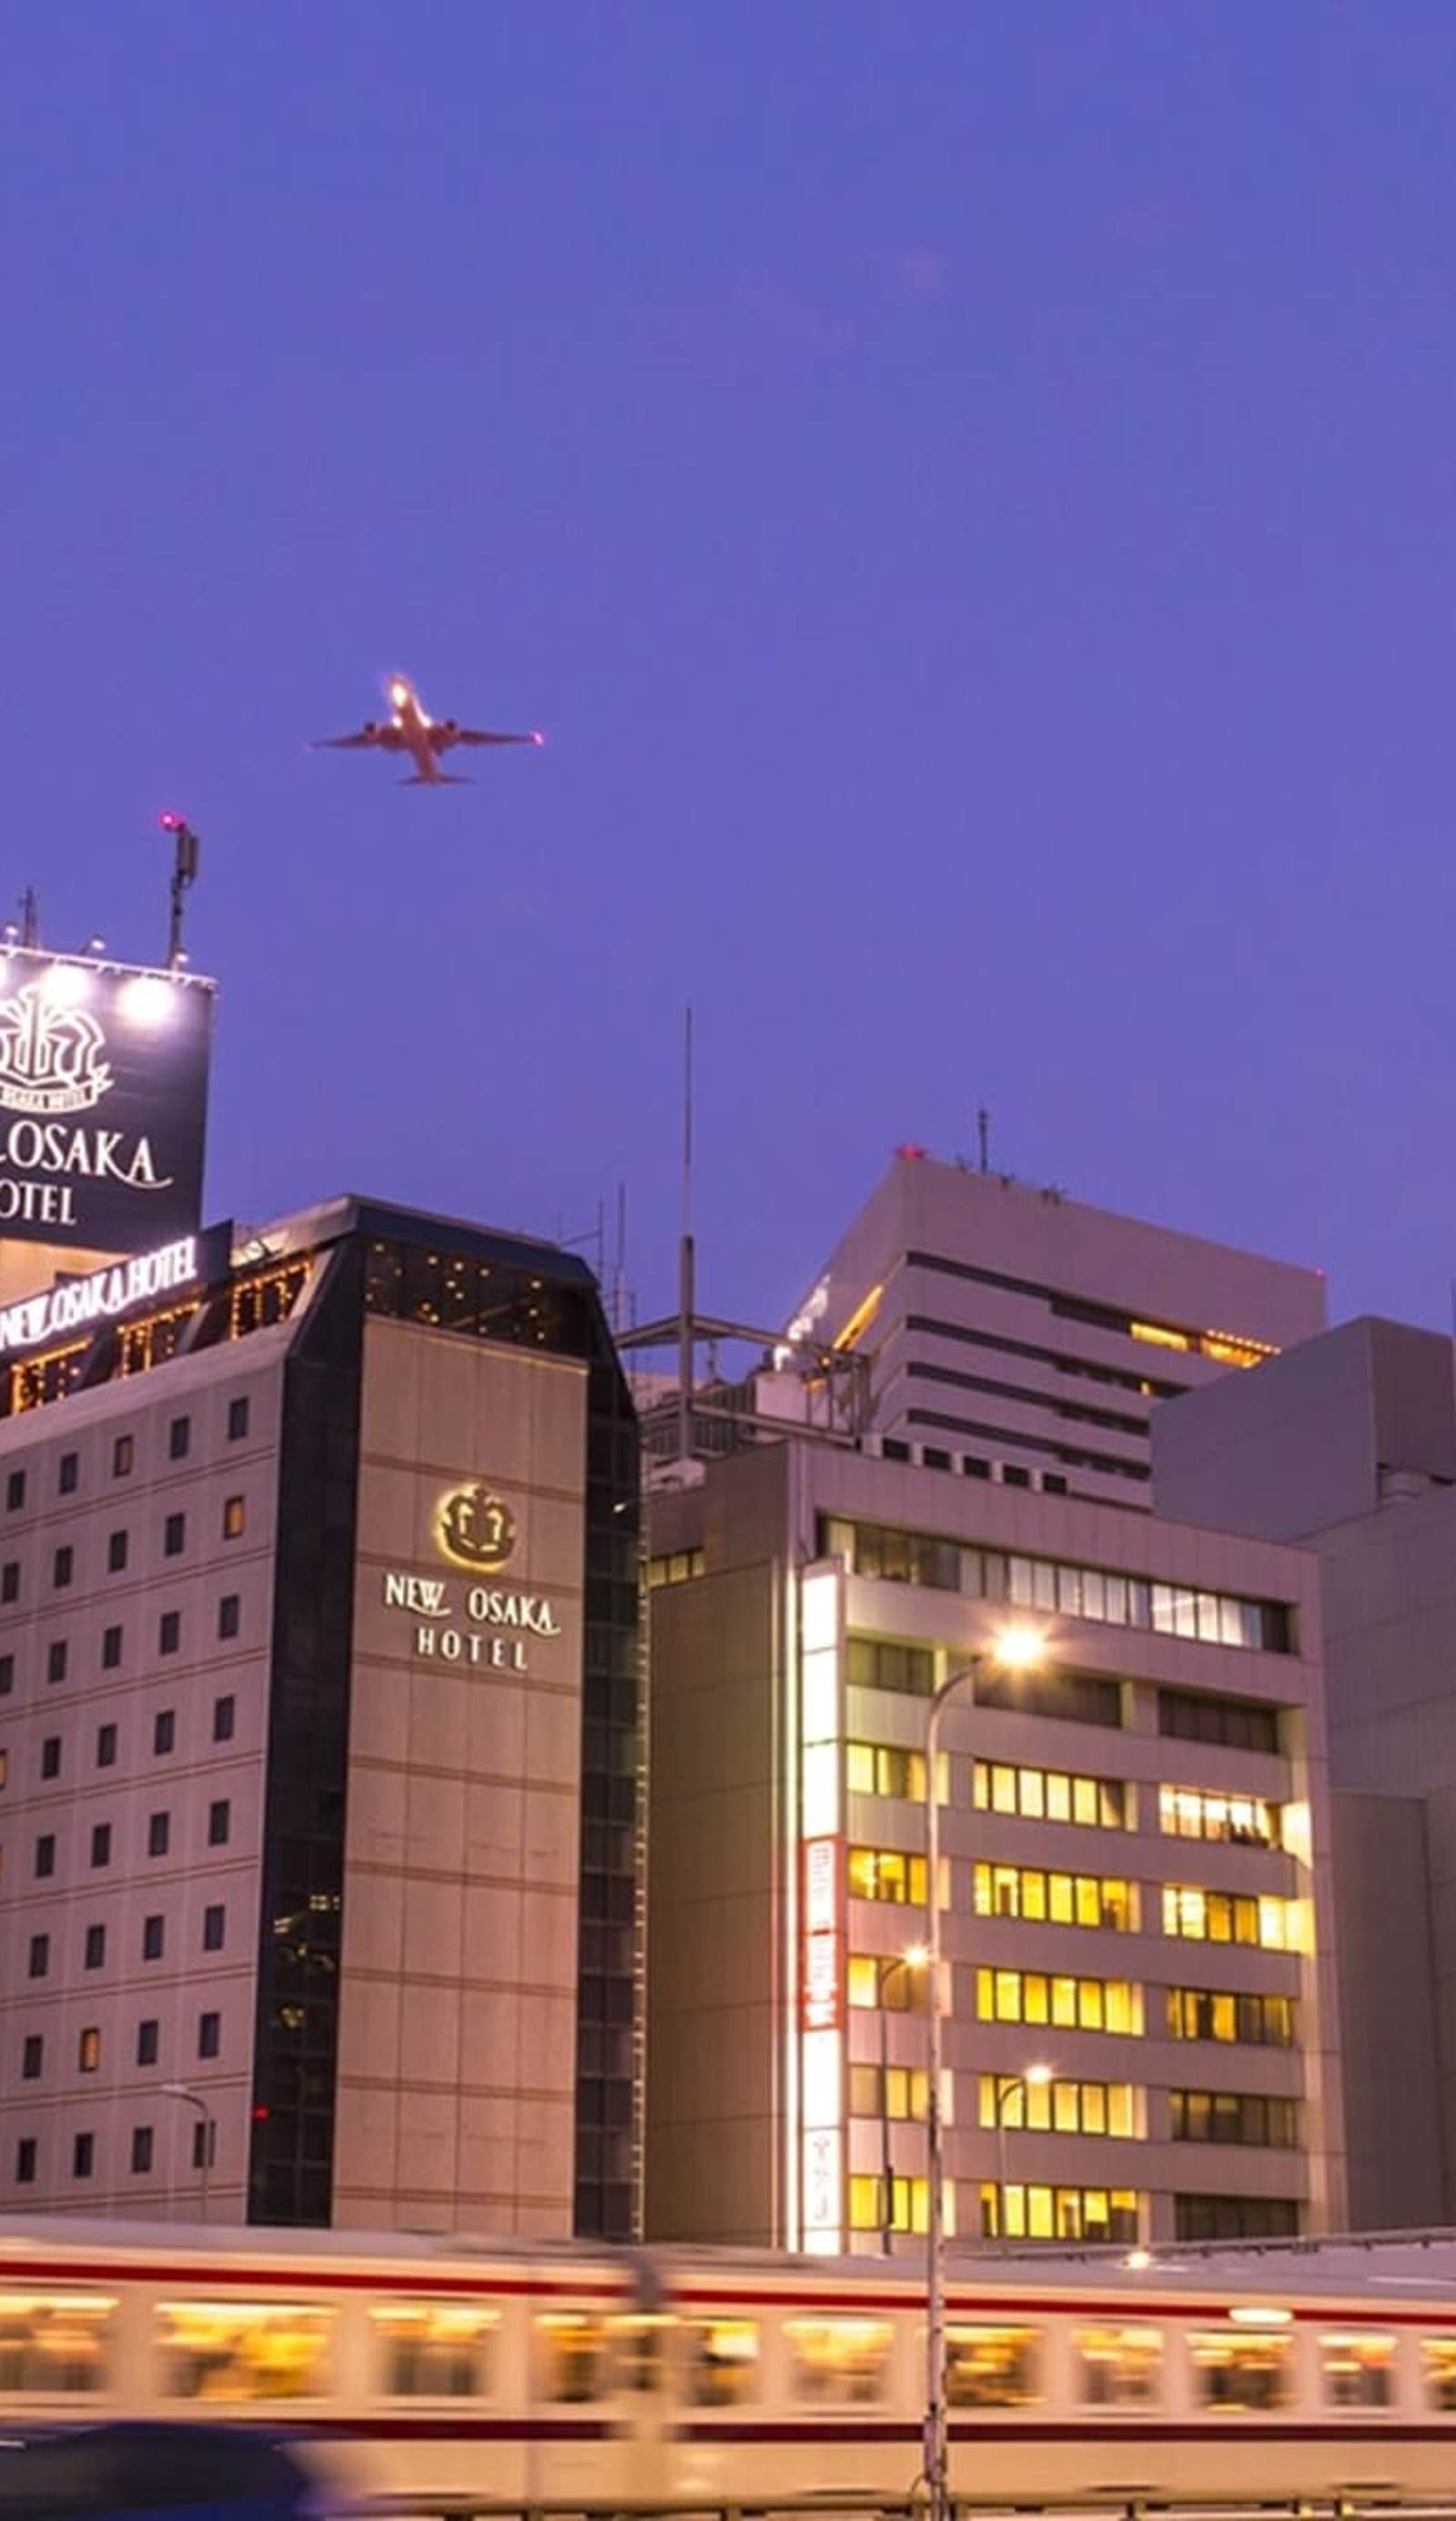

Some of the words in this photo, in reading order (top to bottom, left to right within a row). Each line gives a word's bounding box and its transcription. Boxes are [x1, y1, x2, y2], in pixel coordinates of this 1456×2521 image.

[8, 1119, 174, 1190] OSAKA
[0, 1291, 54, 1351] NEW
[49, 1265, 129, 1331] OSAKA
[126, 1235, 197, 1305] HOTEL
[385, 1574, 452, 1616] NEW
[469, 1587, 561, 1636] OSAKA
[418, 1627, 528, 1671] HOTEL
